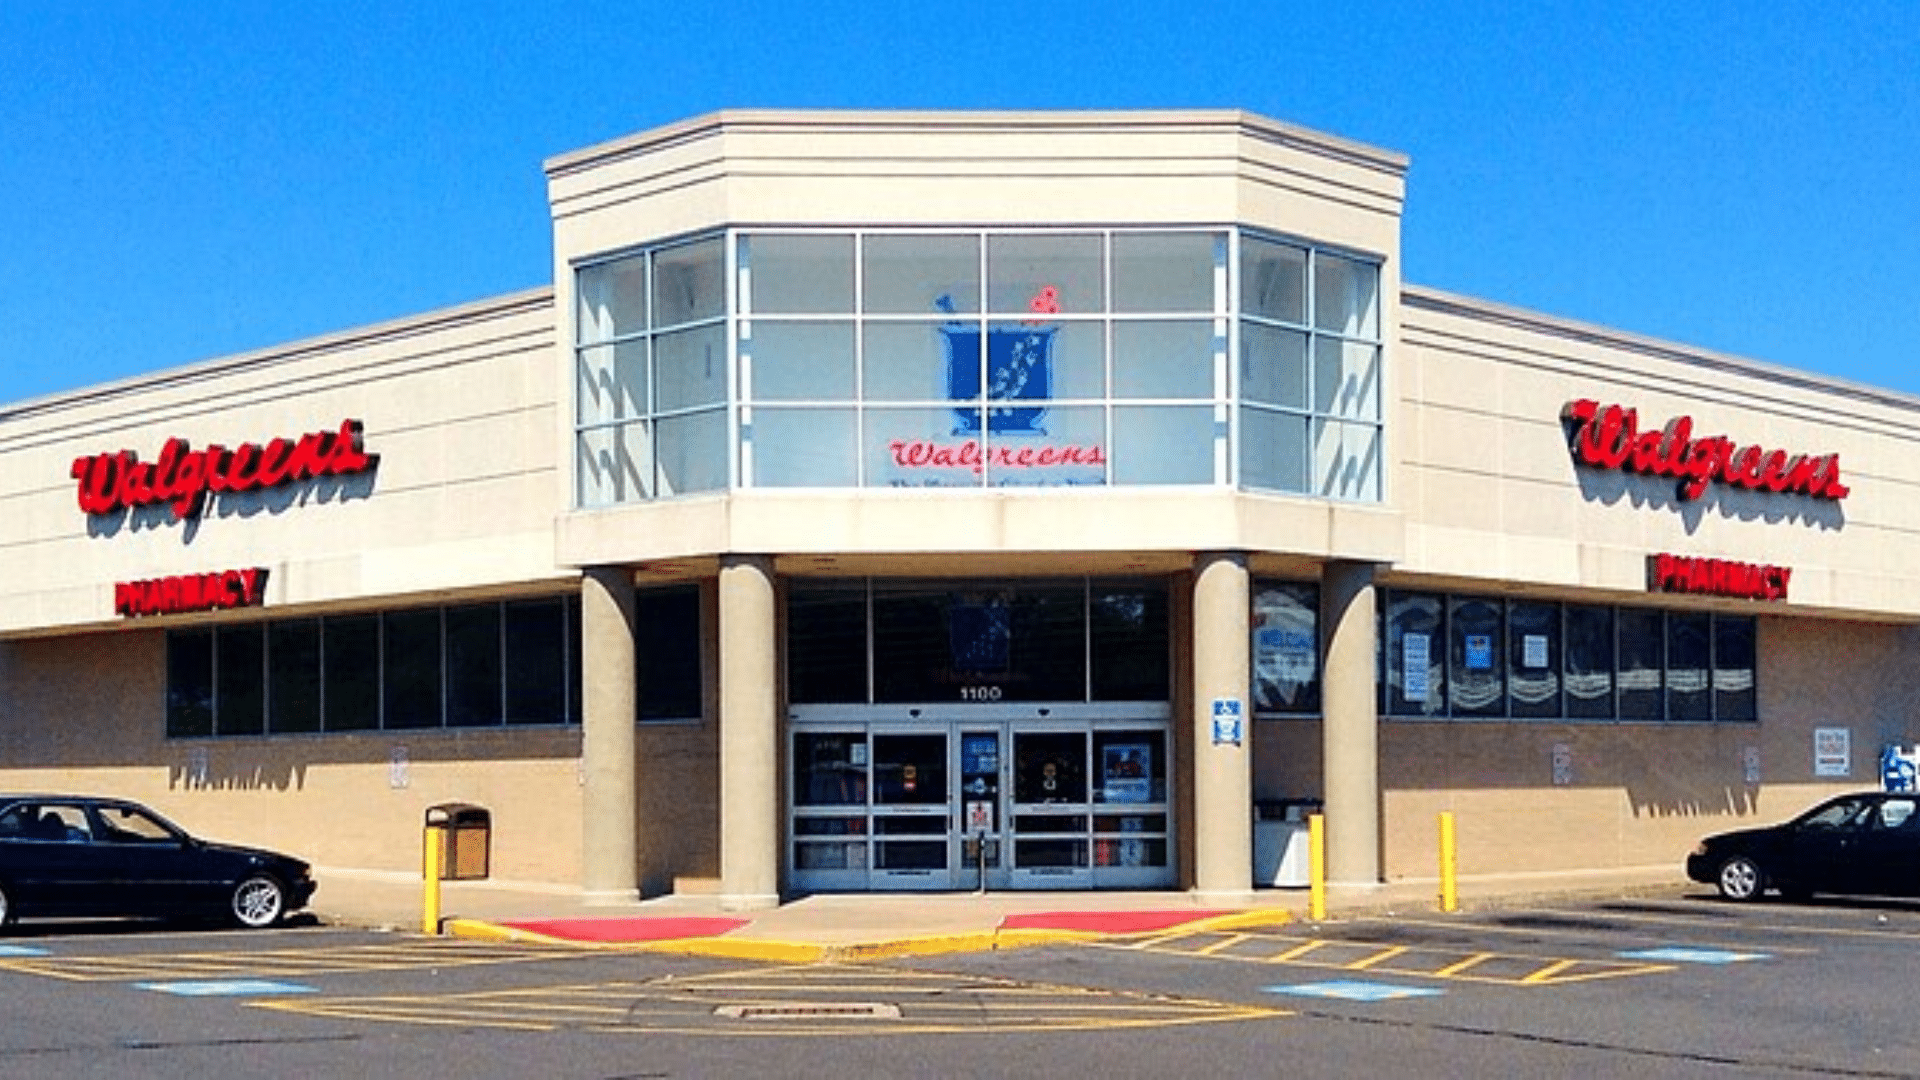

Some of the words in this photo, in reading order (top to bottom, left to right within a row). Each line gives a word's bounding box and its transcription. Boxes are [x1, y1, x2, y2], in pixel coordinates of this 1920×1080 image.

[71, 419, 370, 519] Walgreens
[890, 440, 1107, 476] Walgreens
[1564, 399, 1849, 501] Walgreens
[115, 567, 262, 617] PHARMACY
[1650, 552, 1792, 601] PHARMACY
[960, 686, 1002, 700] 1100
